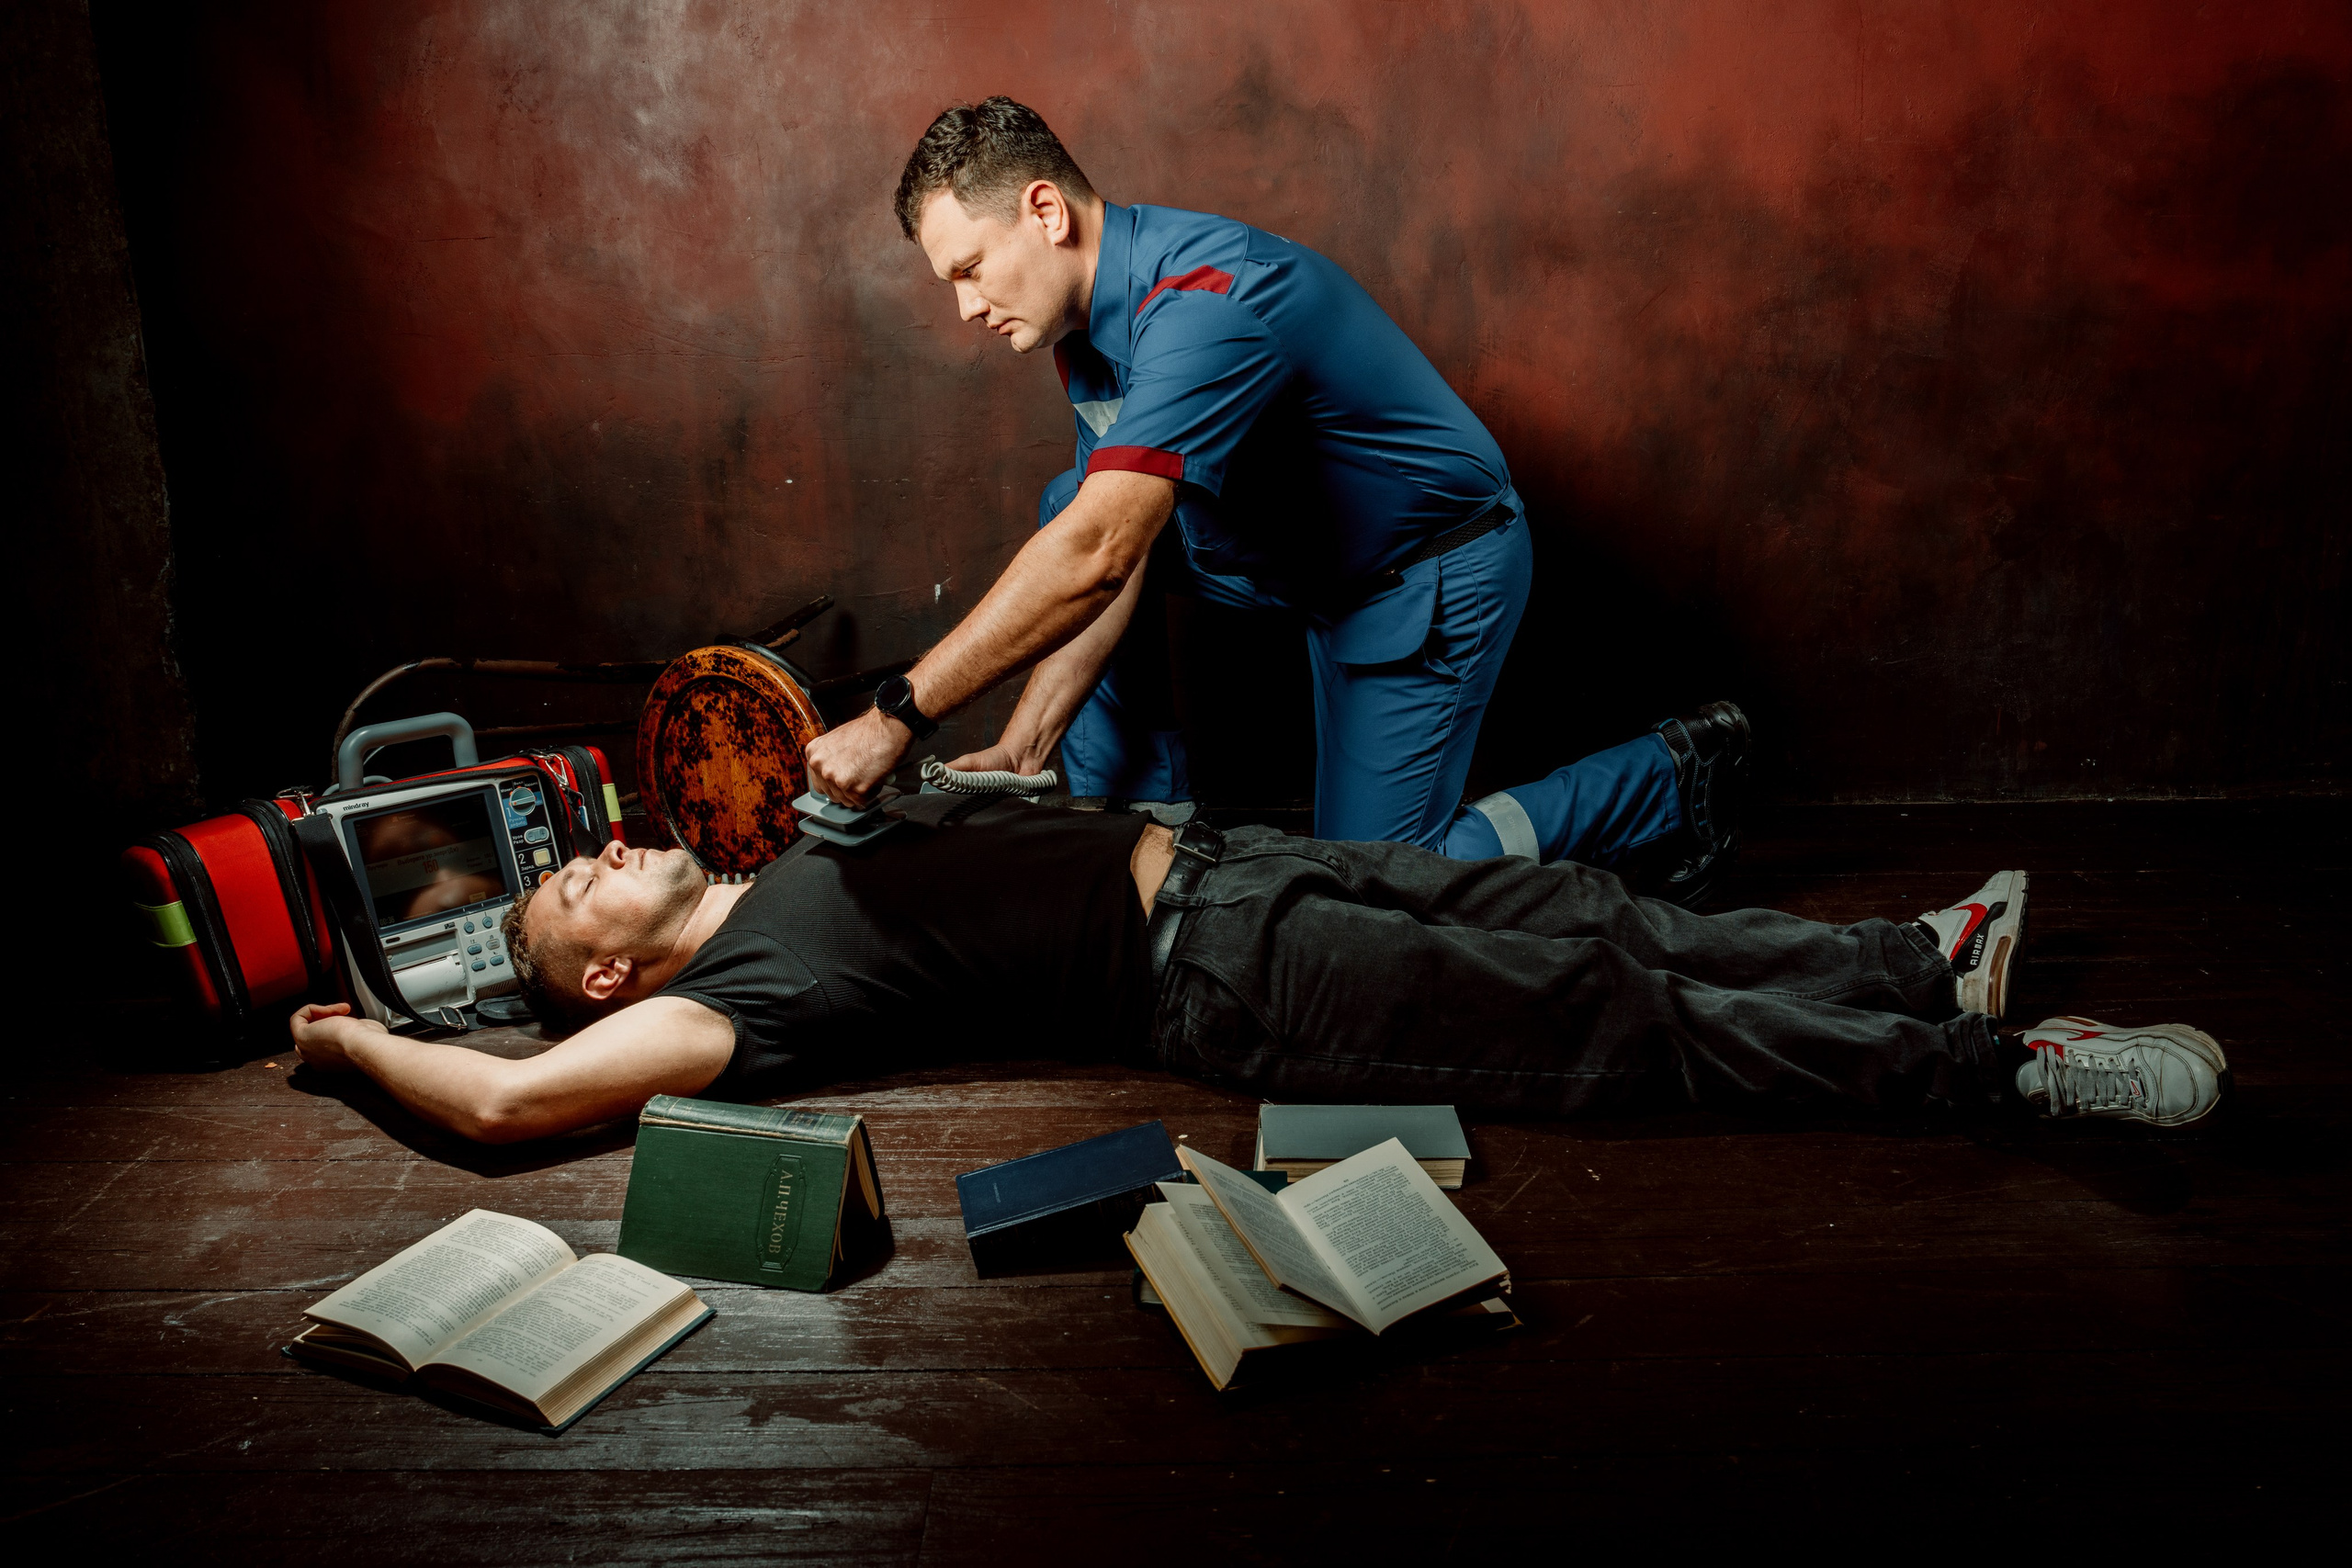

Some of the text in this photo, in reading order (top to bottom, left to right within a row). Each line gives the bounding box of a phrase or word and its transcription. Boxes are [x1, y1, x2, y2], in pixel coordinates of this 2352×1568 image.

[343, 801, 369, 811] mindray
[506, 807, 512, 818] 1
[518, 853, 526, 864] 2
[423, 859, 439, 874] 150
[524, 875, 531, 886] 3
[769, 1169, 794, 1254] А.П.ЧЕХОВ
